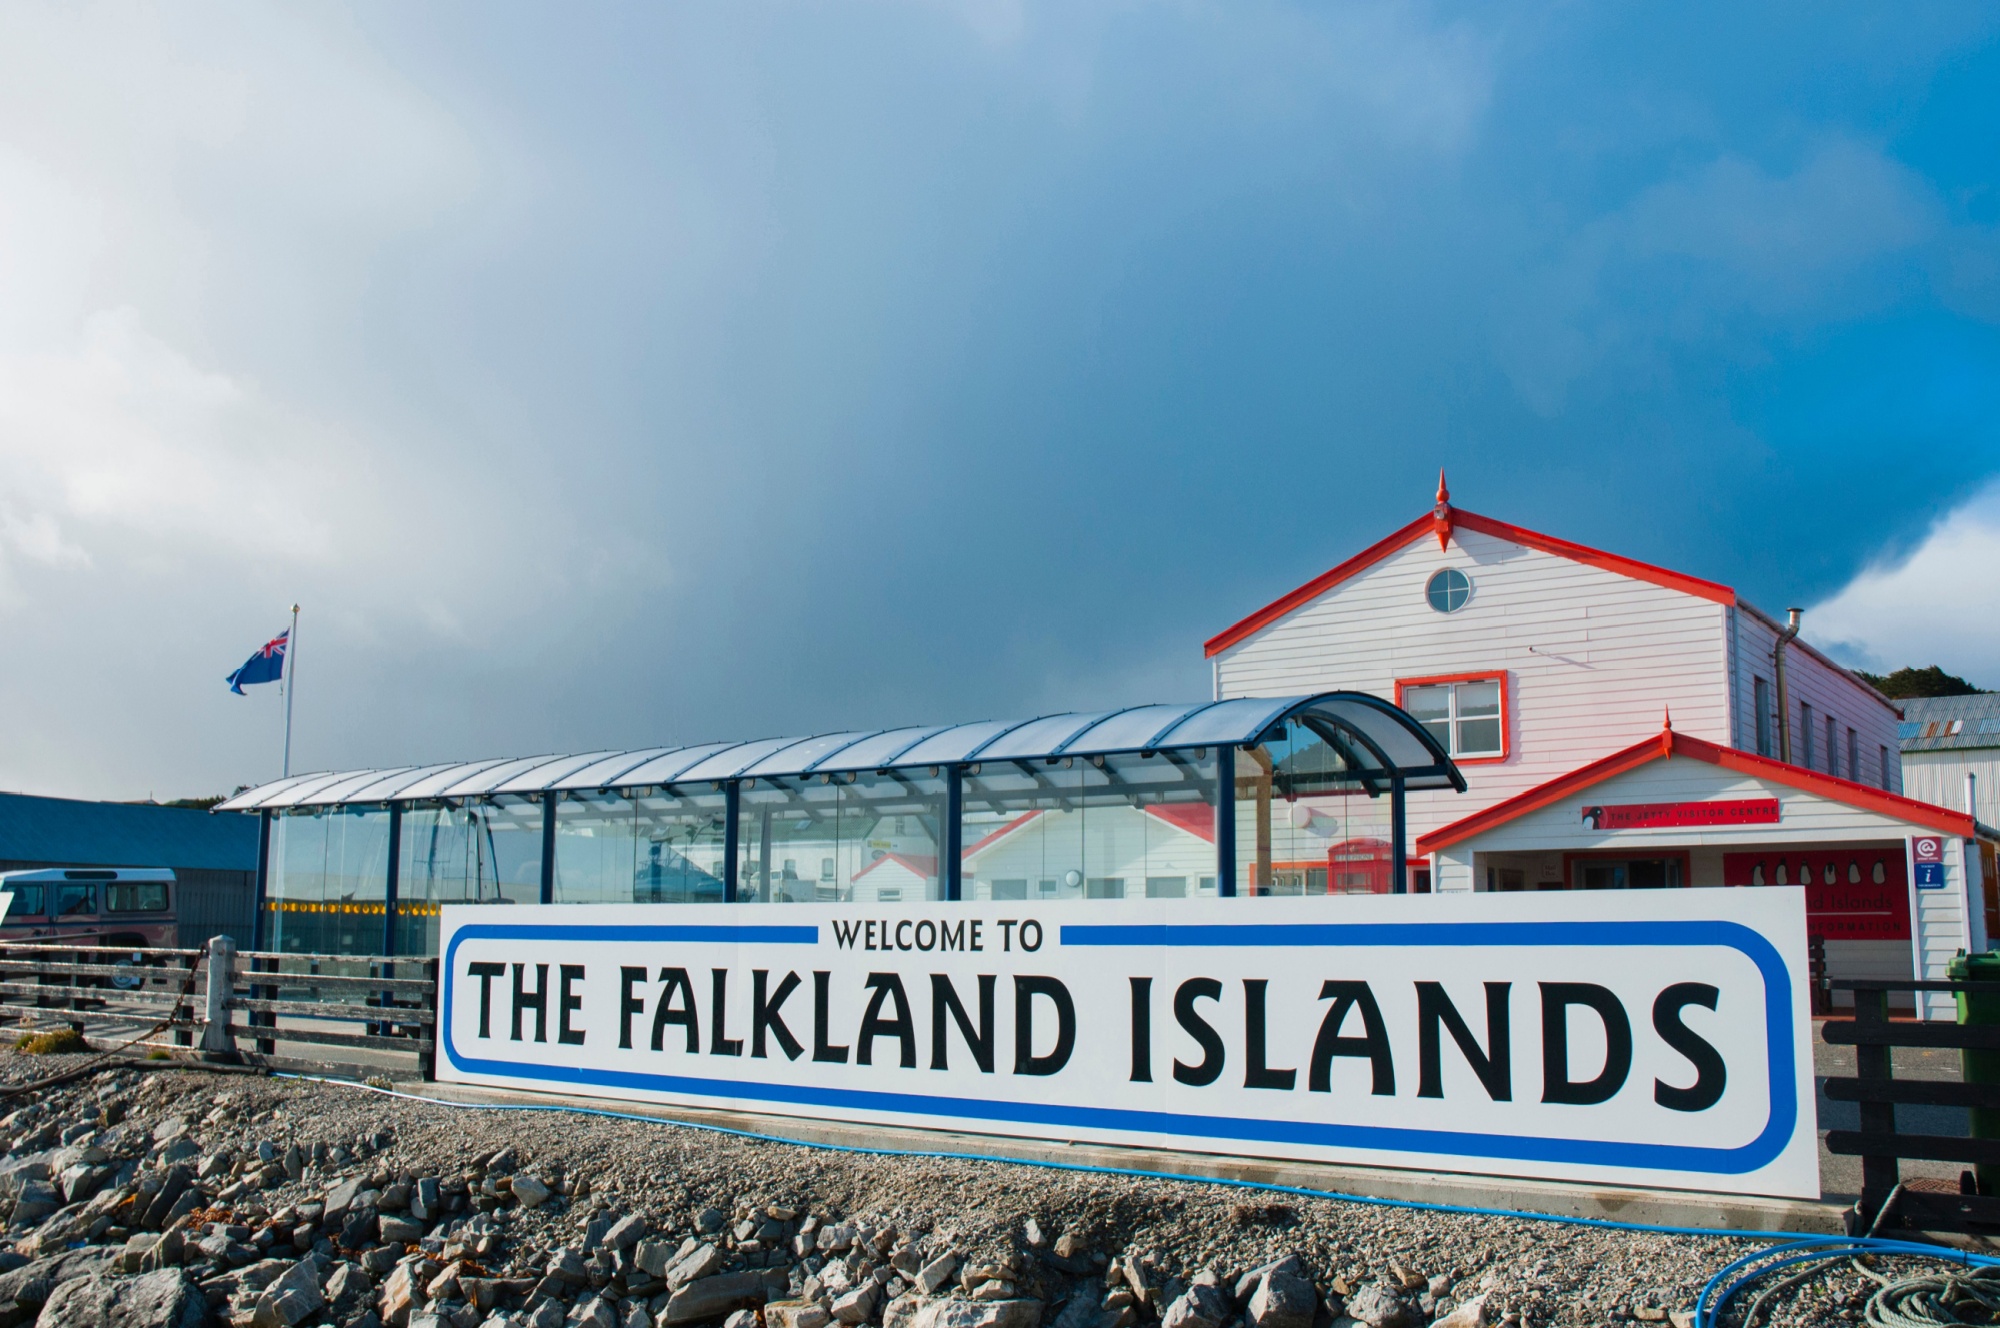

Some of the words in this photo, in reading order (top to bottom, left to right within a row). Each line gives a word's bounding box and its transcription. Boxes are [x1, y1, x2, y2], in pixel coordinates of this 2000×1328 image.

[1610, 812, 1631, 821] THE
[1636, 810, 1671, 820] JETTY
[1676, 808, 1725, 818] VISITOR
[1730, 805, 1777, 817] CENTRE
[1808, 894, 1824, 909] nd
[1831, 893, 1893, 909] Islands
[1808, 922, 1901, 931] NFORMATION
[832, 919, 984, 951] WELCOME
[997, 919, 1043, 952] TO
[467, 961, 586, 1046] THE
[618, 965, 1077, 1076] FALKLAND
[1128, 976, 1727, 1112] ISLANDS
